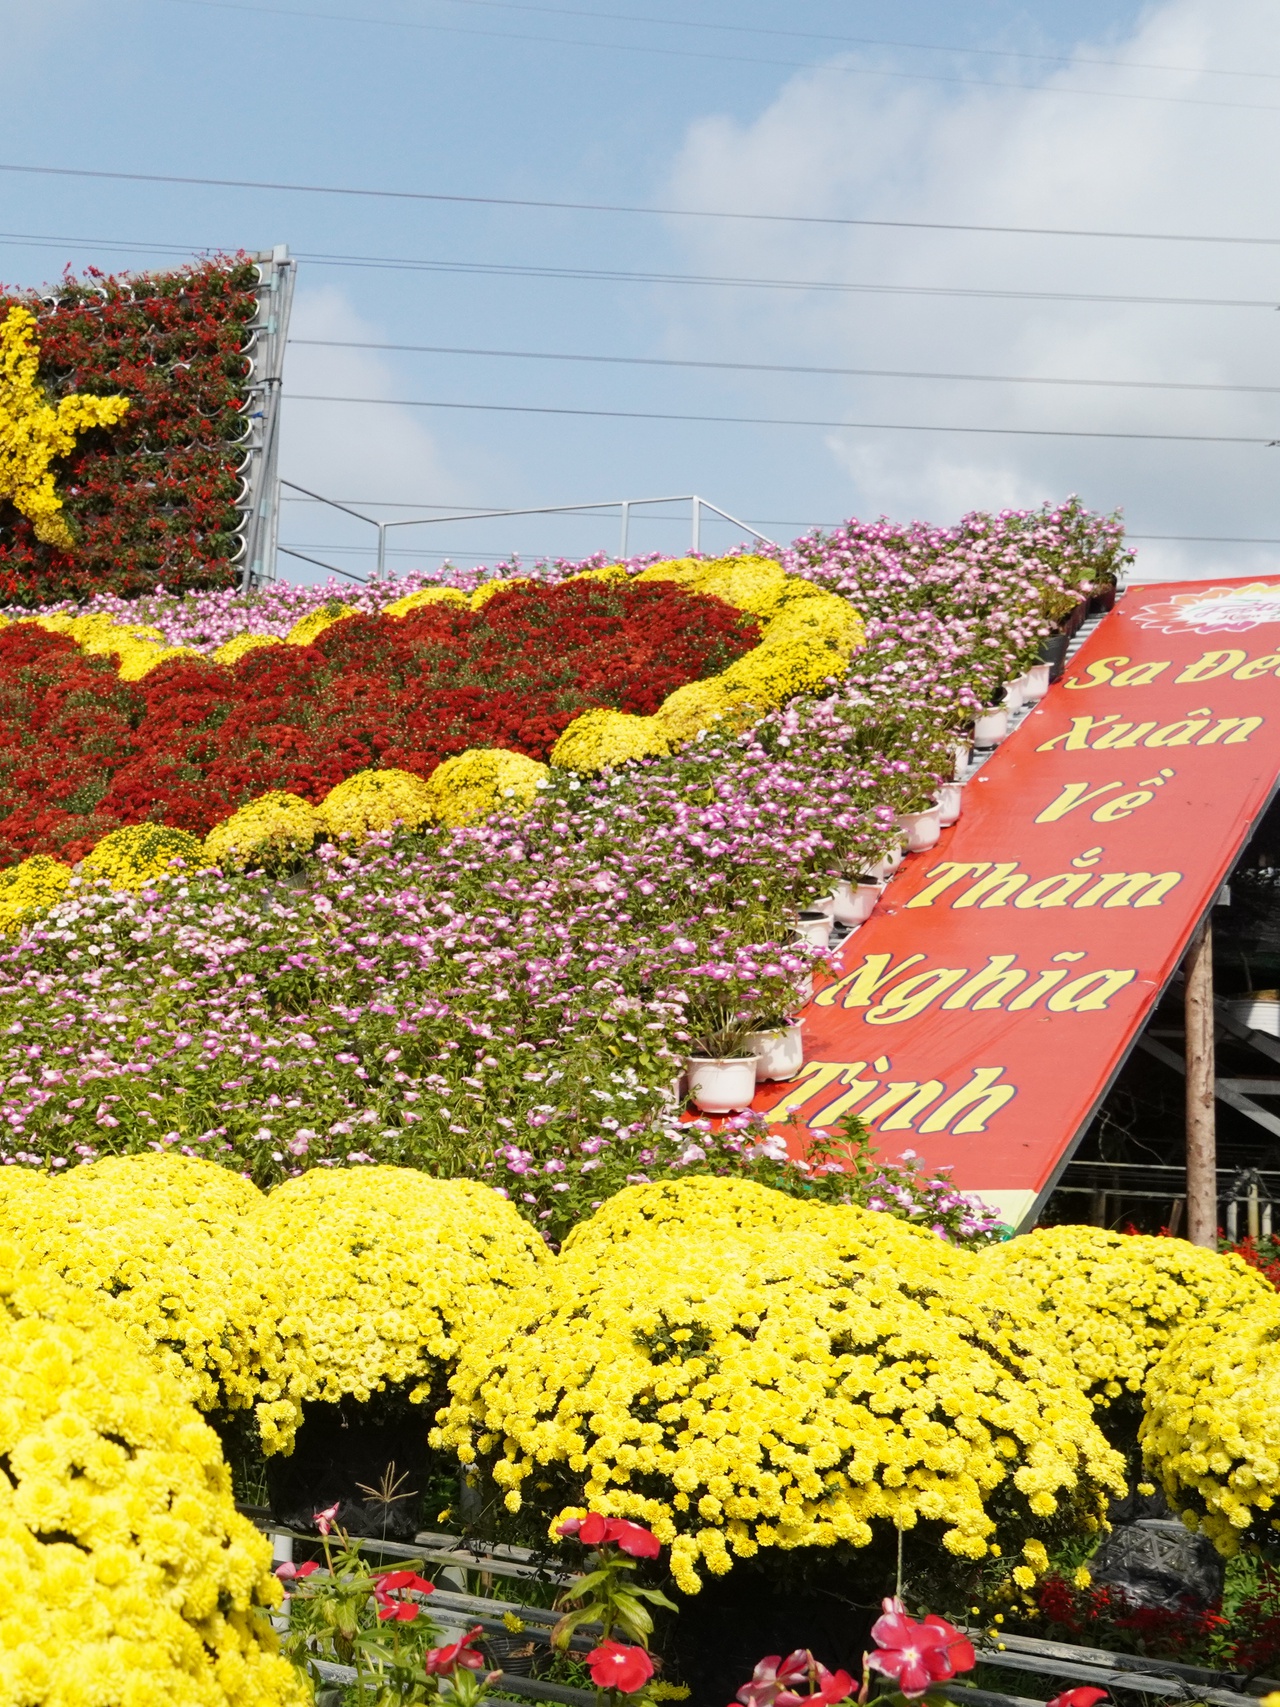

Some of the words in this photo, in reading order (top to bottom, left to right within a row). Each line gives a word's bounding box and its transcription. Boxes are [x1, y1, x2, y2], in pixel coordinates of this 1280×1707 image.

[1063, 656, 1172, 690] Sa
[1173, 646, 1280, 684] Đé
[1035, 707, 1264, 752] Xuân
[1033, 768, 1175, 824] Về
[904, 847, 1183, 909] Thắm
[813, 951, 1138, 1025] Nghĩa
[763, 1055, 1019, 1135] Tình
